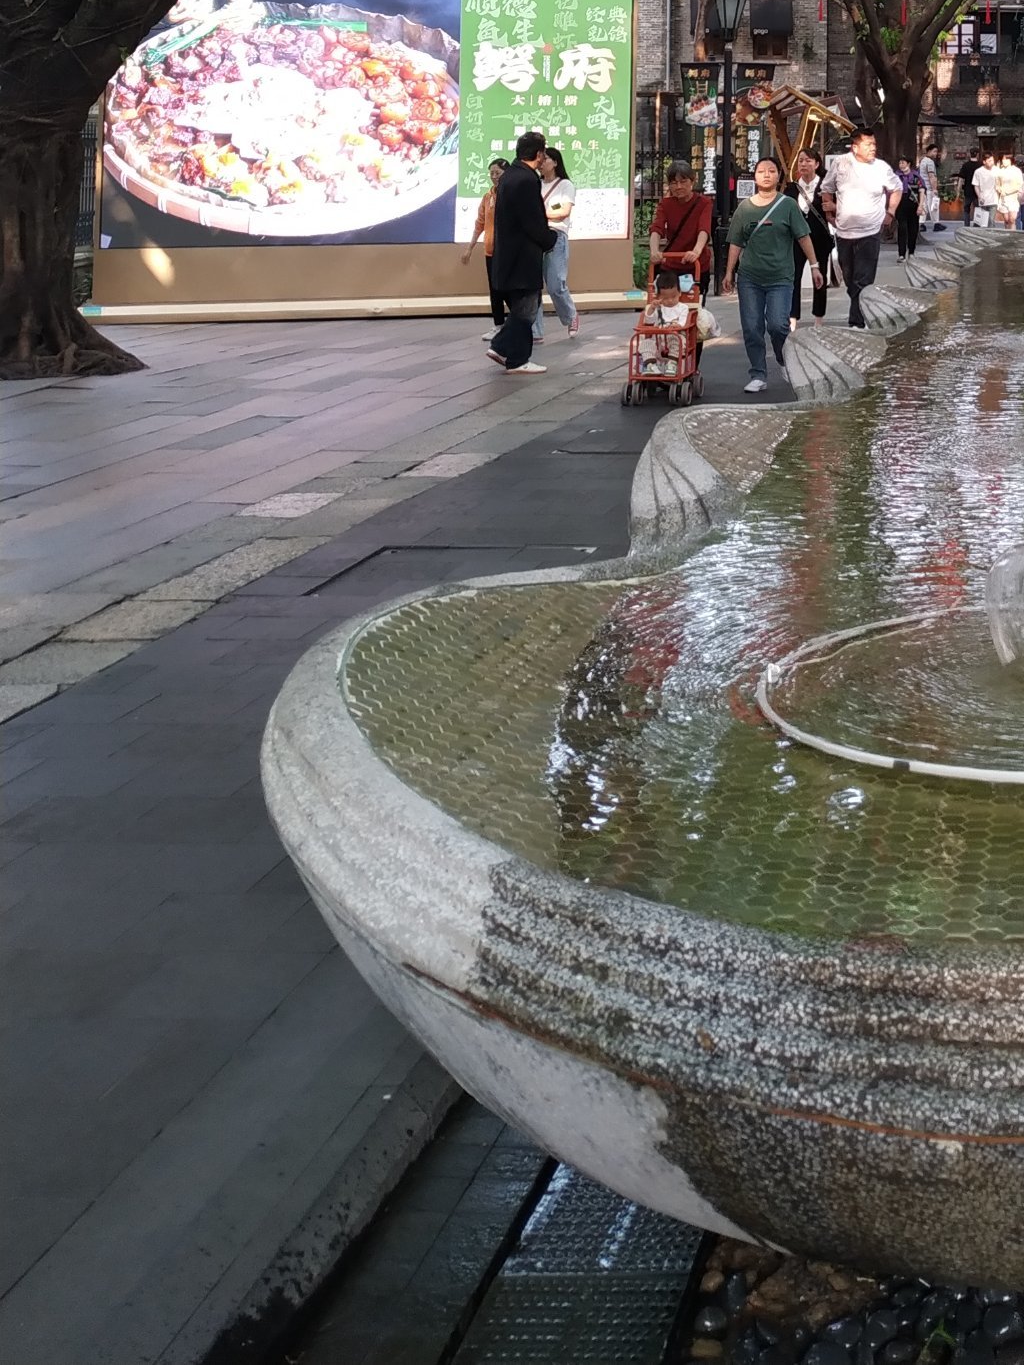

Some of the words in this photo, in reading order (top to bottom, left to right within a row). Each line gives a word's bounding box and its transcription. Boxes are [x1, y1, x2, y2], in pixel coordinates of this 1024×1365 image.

[585, 5, 628, 24] 经典
[472, 18, 546, 48] 鱼生
[587, 24, 628, 43] 乳鸽
[465, 93, 485, 142] 白切鸡
[573, 147, 623, 170] 火焰
